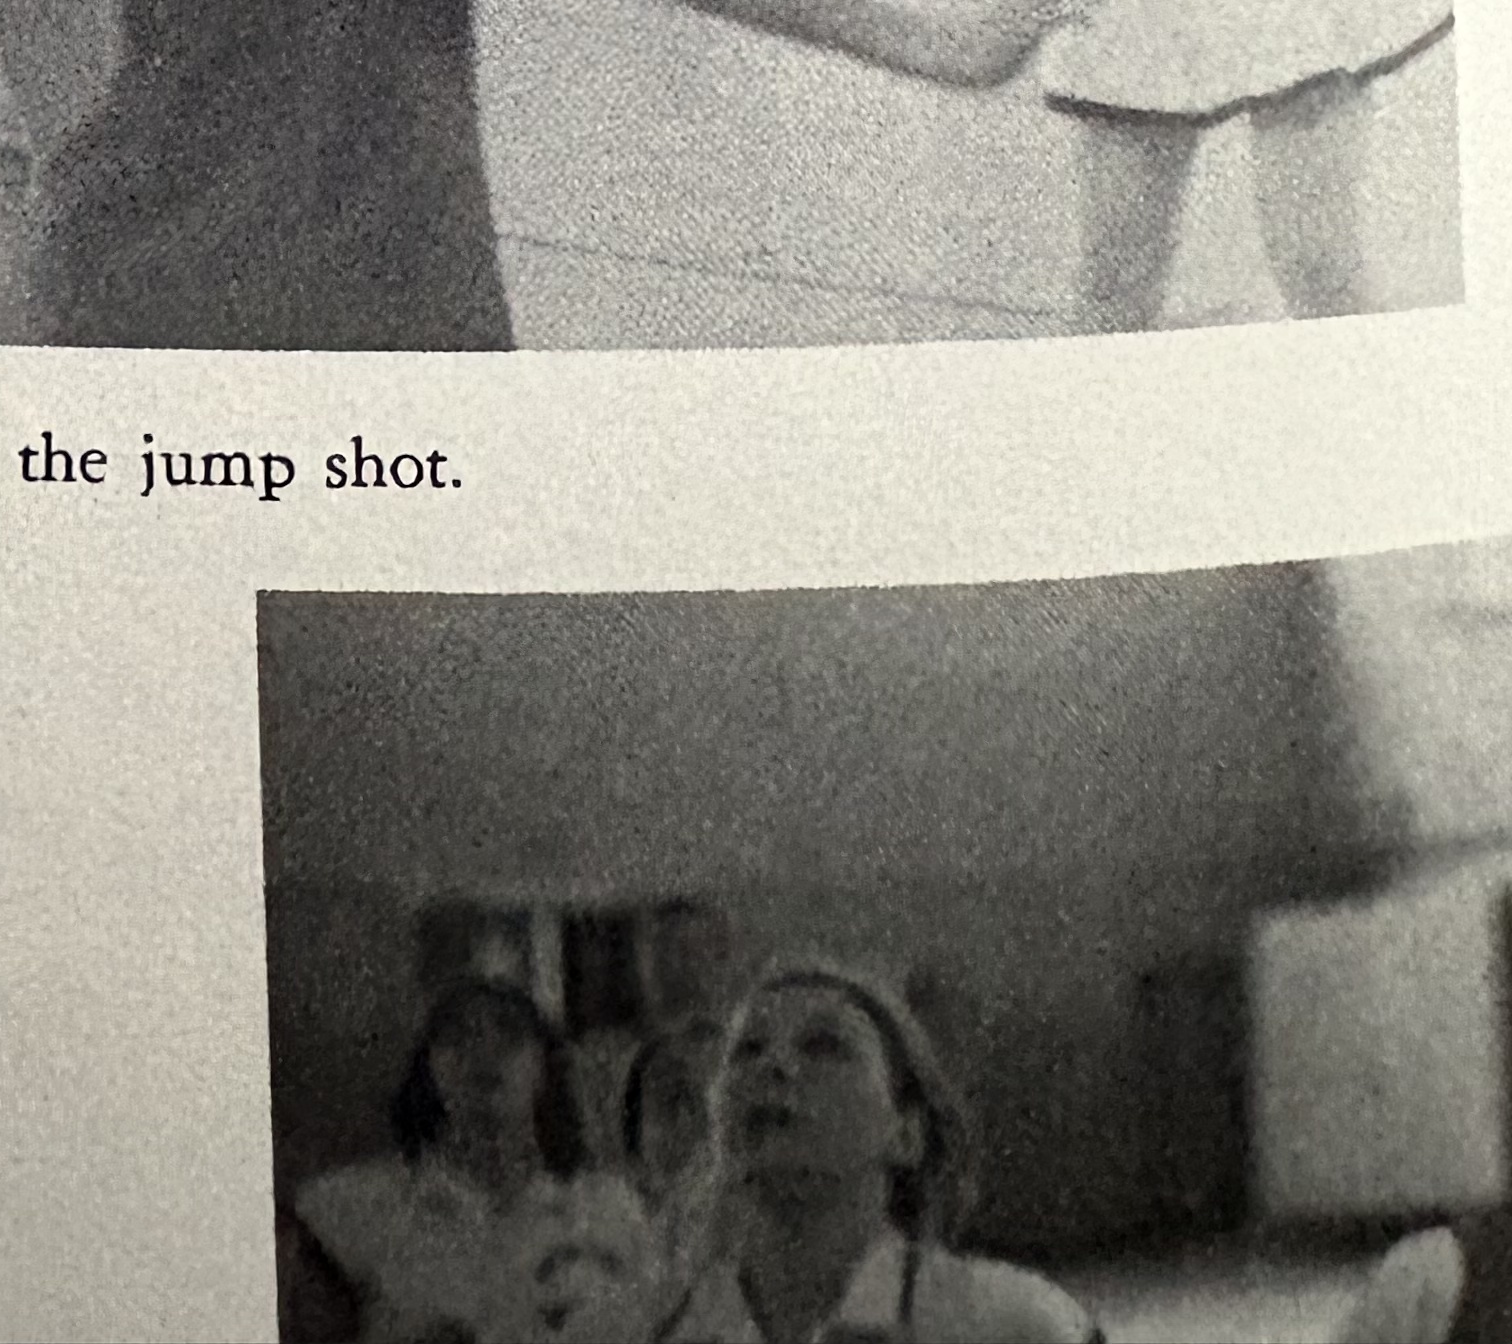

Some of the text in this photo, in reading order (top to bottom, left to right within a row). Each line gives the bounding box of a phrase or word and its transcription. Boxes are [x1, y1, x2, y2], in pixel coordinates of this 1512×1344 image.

[18, 430, 108, 485] the
[140, 433, 296, 503] jump
[325, 435, 463, 490] shot.
